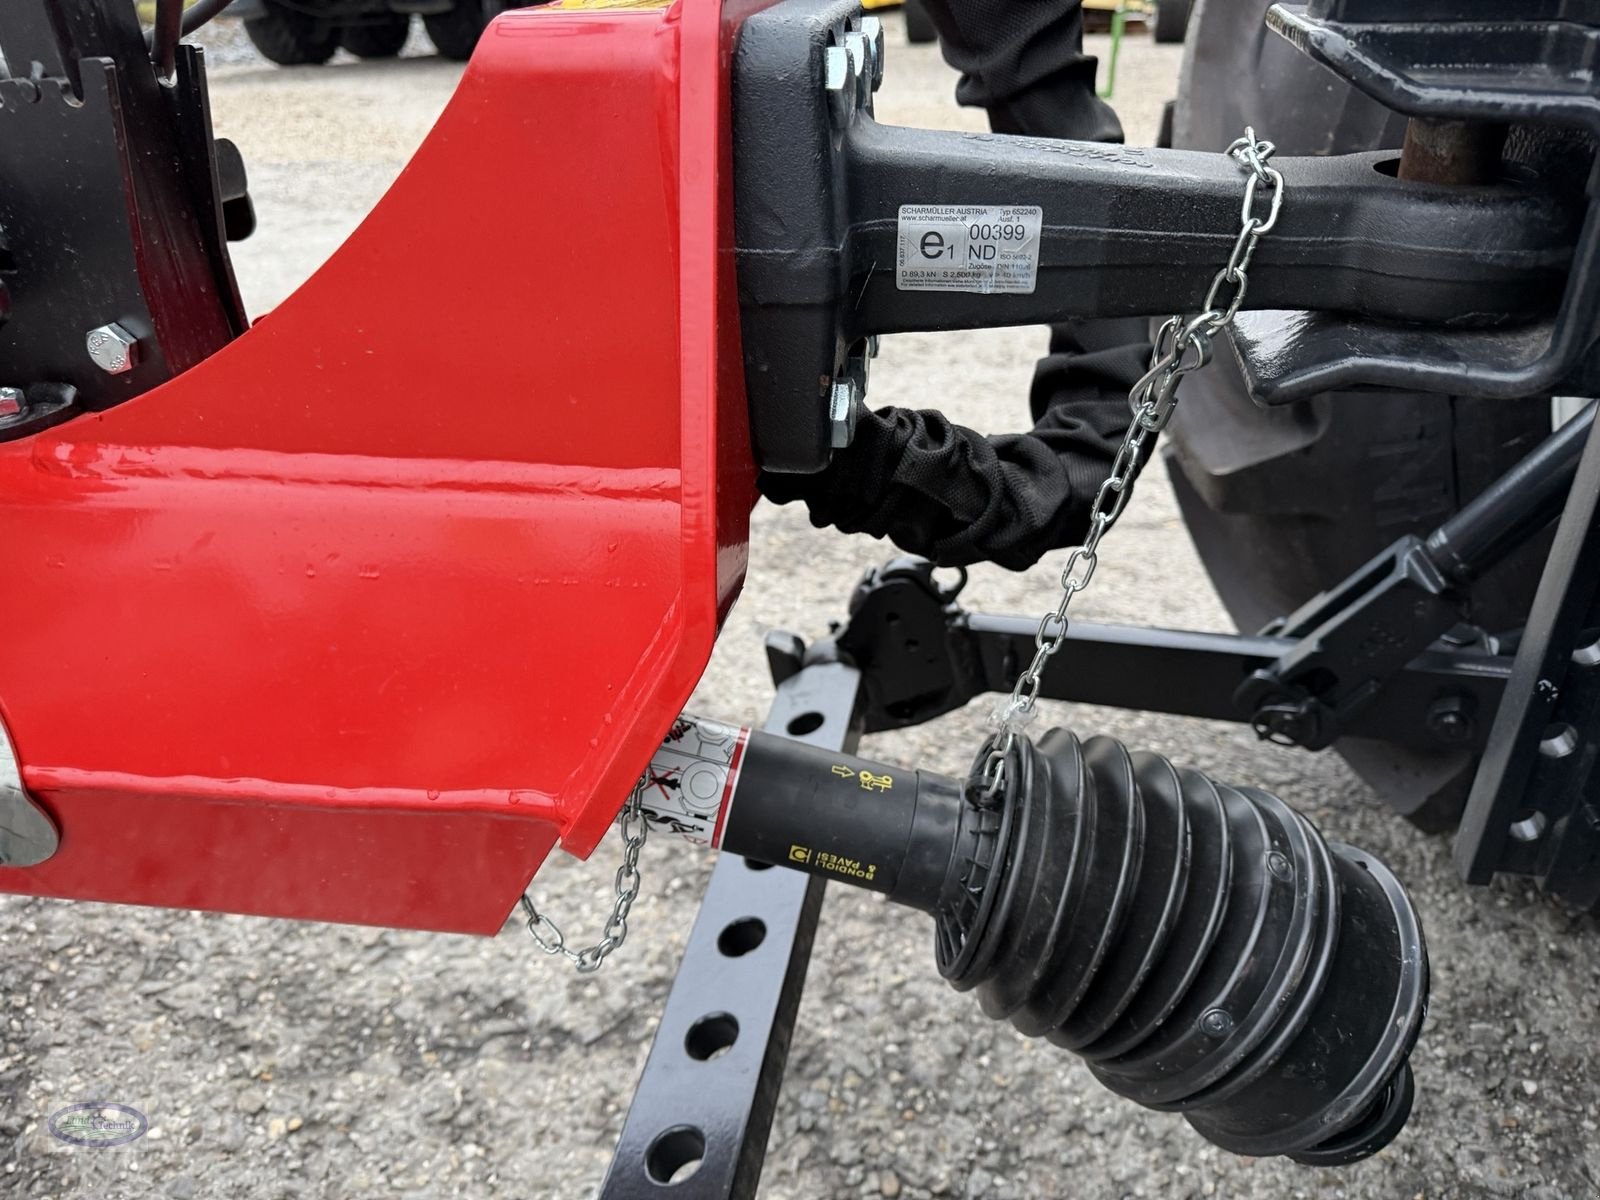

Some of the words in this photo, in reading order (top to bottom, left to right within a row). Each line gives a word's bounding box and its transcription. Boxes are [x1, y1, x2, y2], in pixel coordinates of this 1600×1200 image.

[902, 206, 955, 215] SCHARMÜLLER
[999, 208, 1011, 216] Typ
[1012, 208, 1037, 216] 652240
[969, 224, 1025, 240] 00399
[968, 244, 997, 260] ND
[816, 852, 860, 870] PAVESI
[868, 864, 877, 873] &
[815, 859, 874, 880] BONDIOLI
